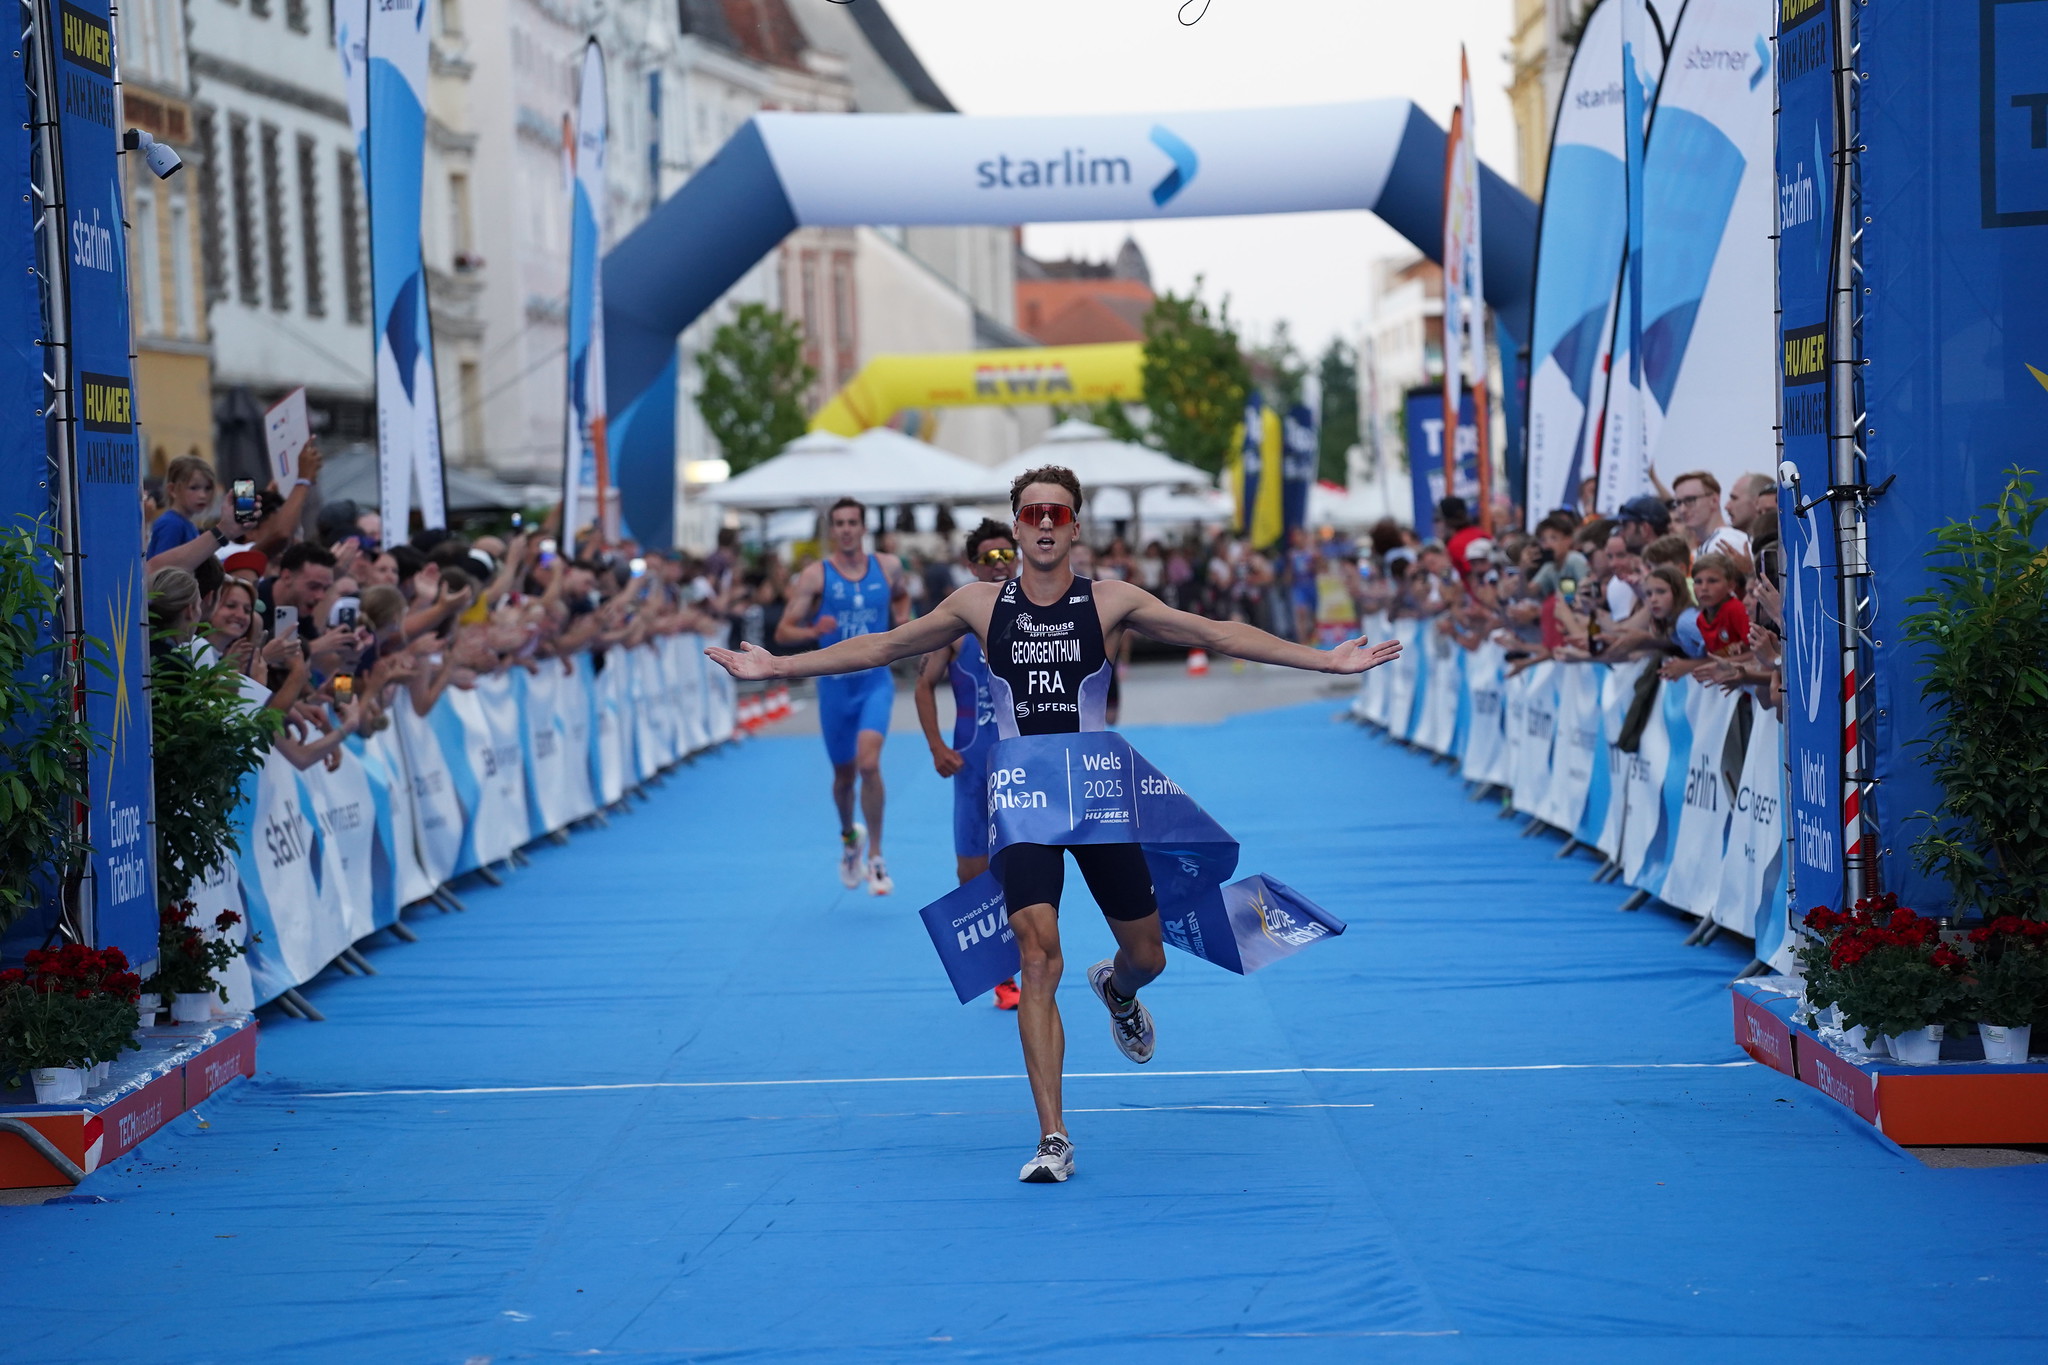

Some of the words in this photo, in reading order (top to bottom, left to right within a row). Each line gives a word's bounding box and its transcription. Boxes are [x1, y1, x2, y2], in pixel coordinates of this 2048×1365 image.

[64, 12, 111, 68] HUMER
[1781, 22, 1826, 86] ANHÄNGER
[1576, 81, 1625, 109] starli
[976, 147, 1131, 189] starlim
[1782, 161, 1813, 231] starlim
[73, 208, 113, 273] starlim
[1785, 333, 1825, 377] HUMER
[85, 383, 131, 424] HUMER
[1023, 621, 1074, 633] Mulhouse
[1011, 639, 1082, 665] GEORGENTHUM
[1028, 670, 1066, 695] FRA
[1082, 752, 1122, 771] Wels
[1800, 747, 1826, 808] World
[1083, 779, 1123, 799] 2025
[110, 800, 140, 850] Europe
[1084, 811, 1130, 820] HUMER
[1798, 809, 1834, 873] Triathlon
[109, 851, 145, 907] Triathlon
[951, 907, 983, 929] Christa
